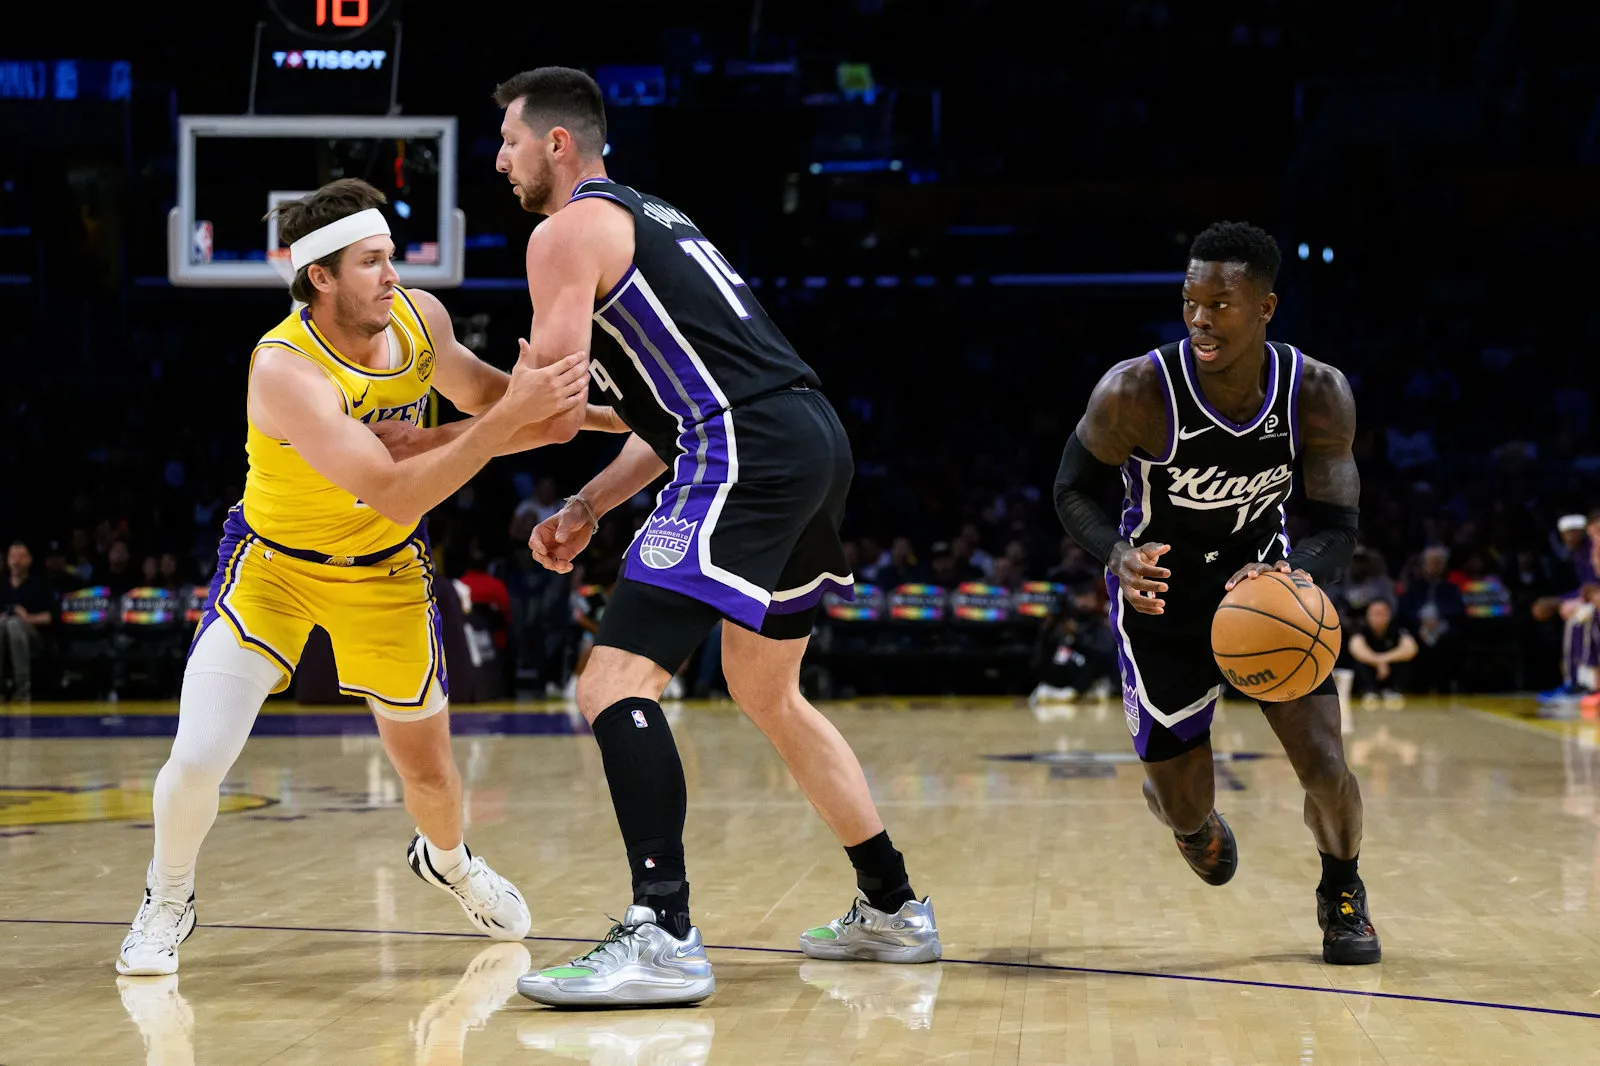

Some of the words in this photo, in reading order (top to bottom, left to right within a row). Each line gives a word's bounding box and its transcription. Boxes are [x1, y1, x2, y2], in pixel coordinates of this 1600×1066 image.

[302, 50, 387, 70] TISSOT
[1167, 464, 1293, 510] Kings
[1231, 491, 1282, 534] 17
[643, 535, 688, 554] KINGS
